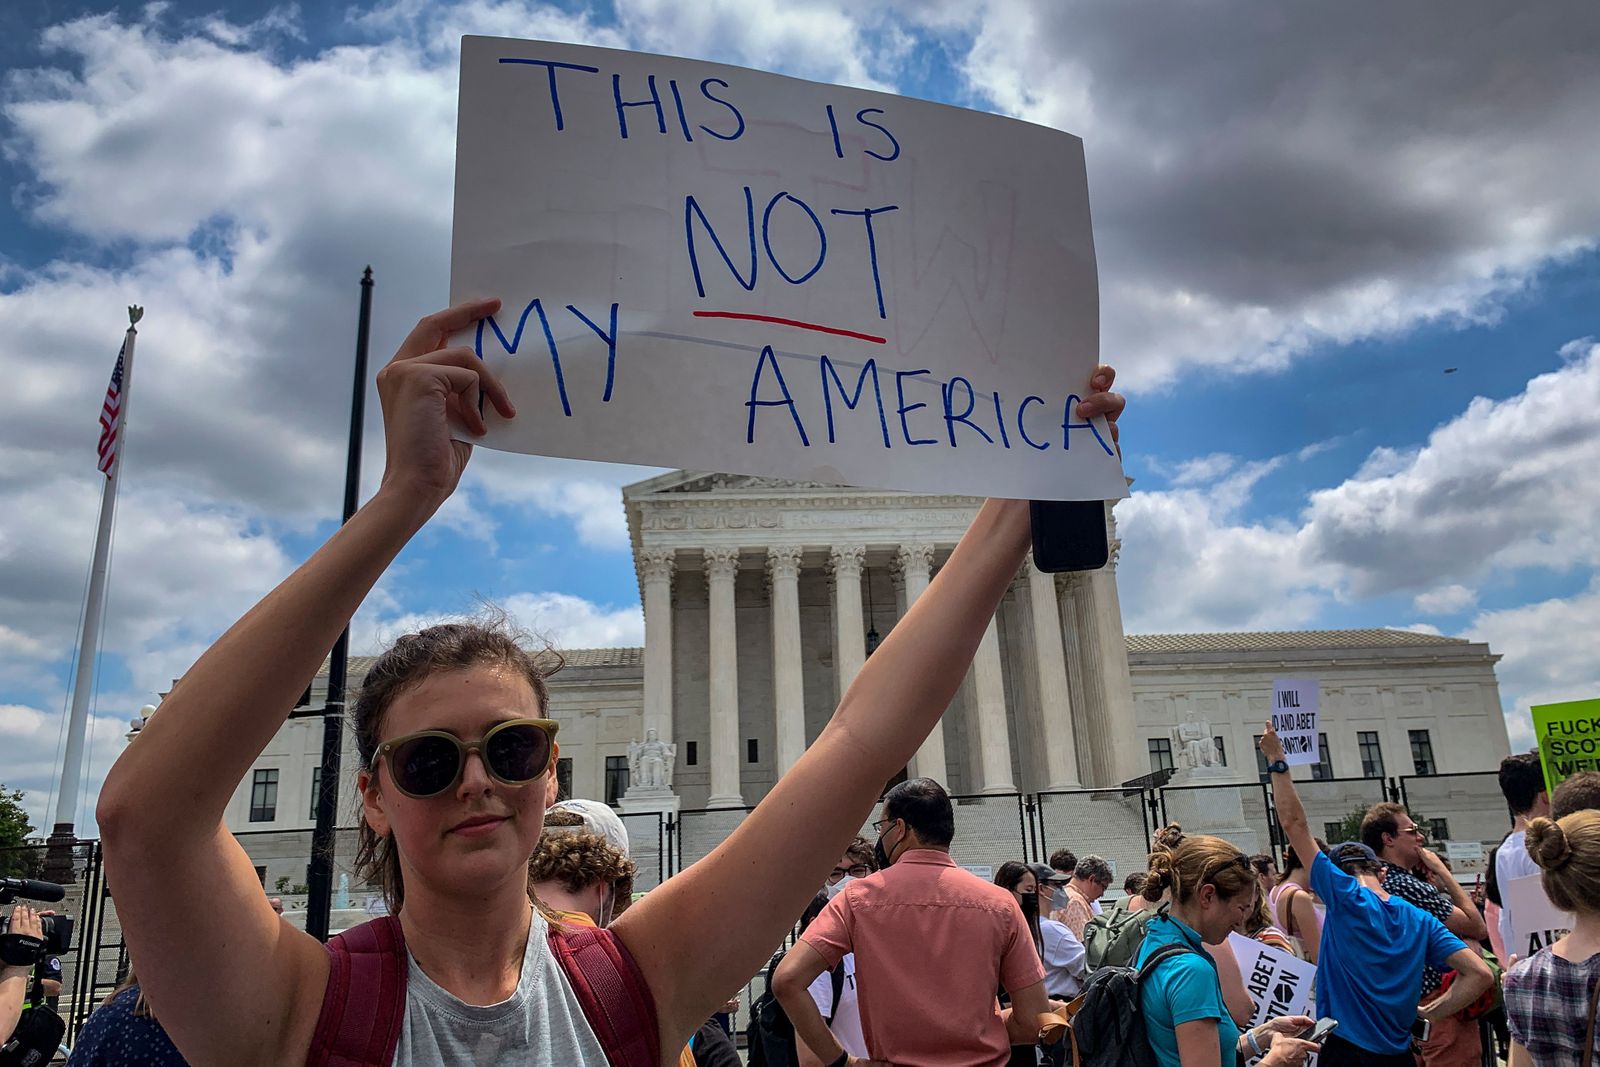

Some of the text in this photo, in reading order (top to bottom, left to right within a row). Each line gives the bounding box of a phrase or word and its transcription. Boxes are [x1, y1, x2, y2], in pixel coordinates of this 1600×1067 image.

[499, 58, 900, 161] THIS IS
[685, 187, 898, 319] NOT
[474, 298, 619, 419] MY
[745, 345, 1114, 457] AMERICA
[1277, 690, 1300, 708] I WILL
[1280, 713, 1295, 731] AND
[1296, 712, 1316, 730] ABET
[1547, 717, 1600, 736] FUCK
[1247, 951, 1277, 1000] ABET
